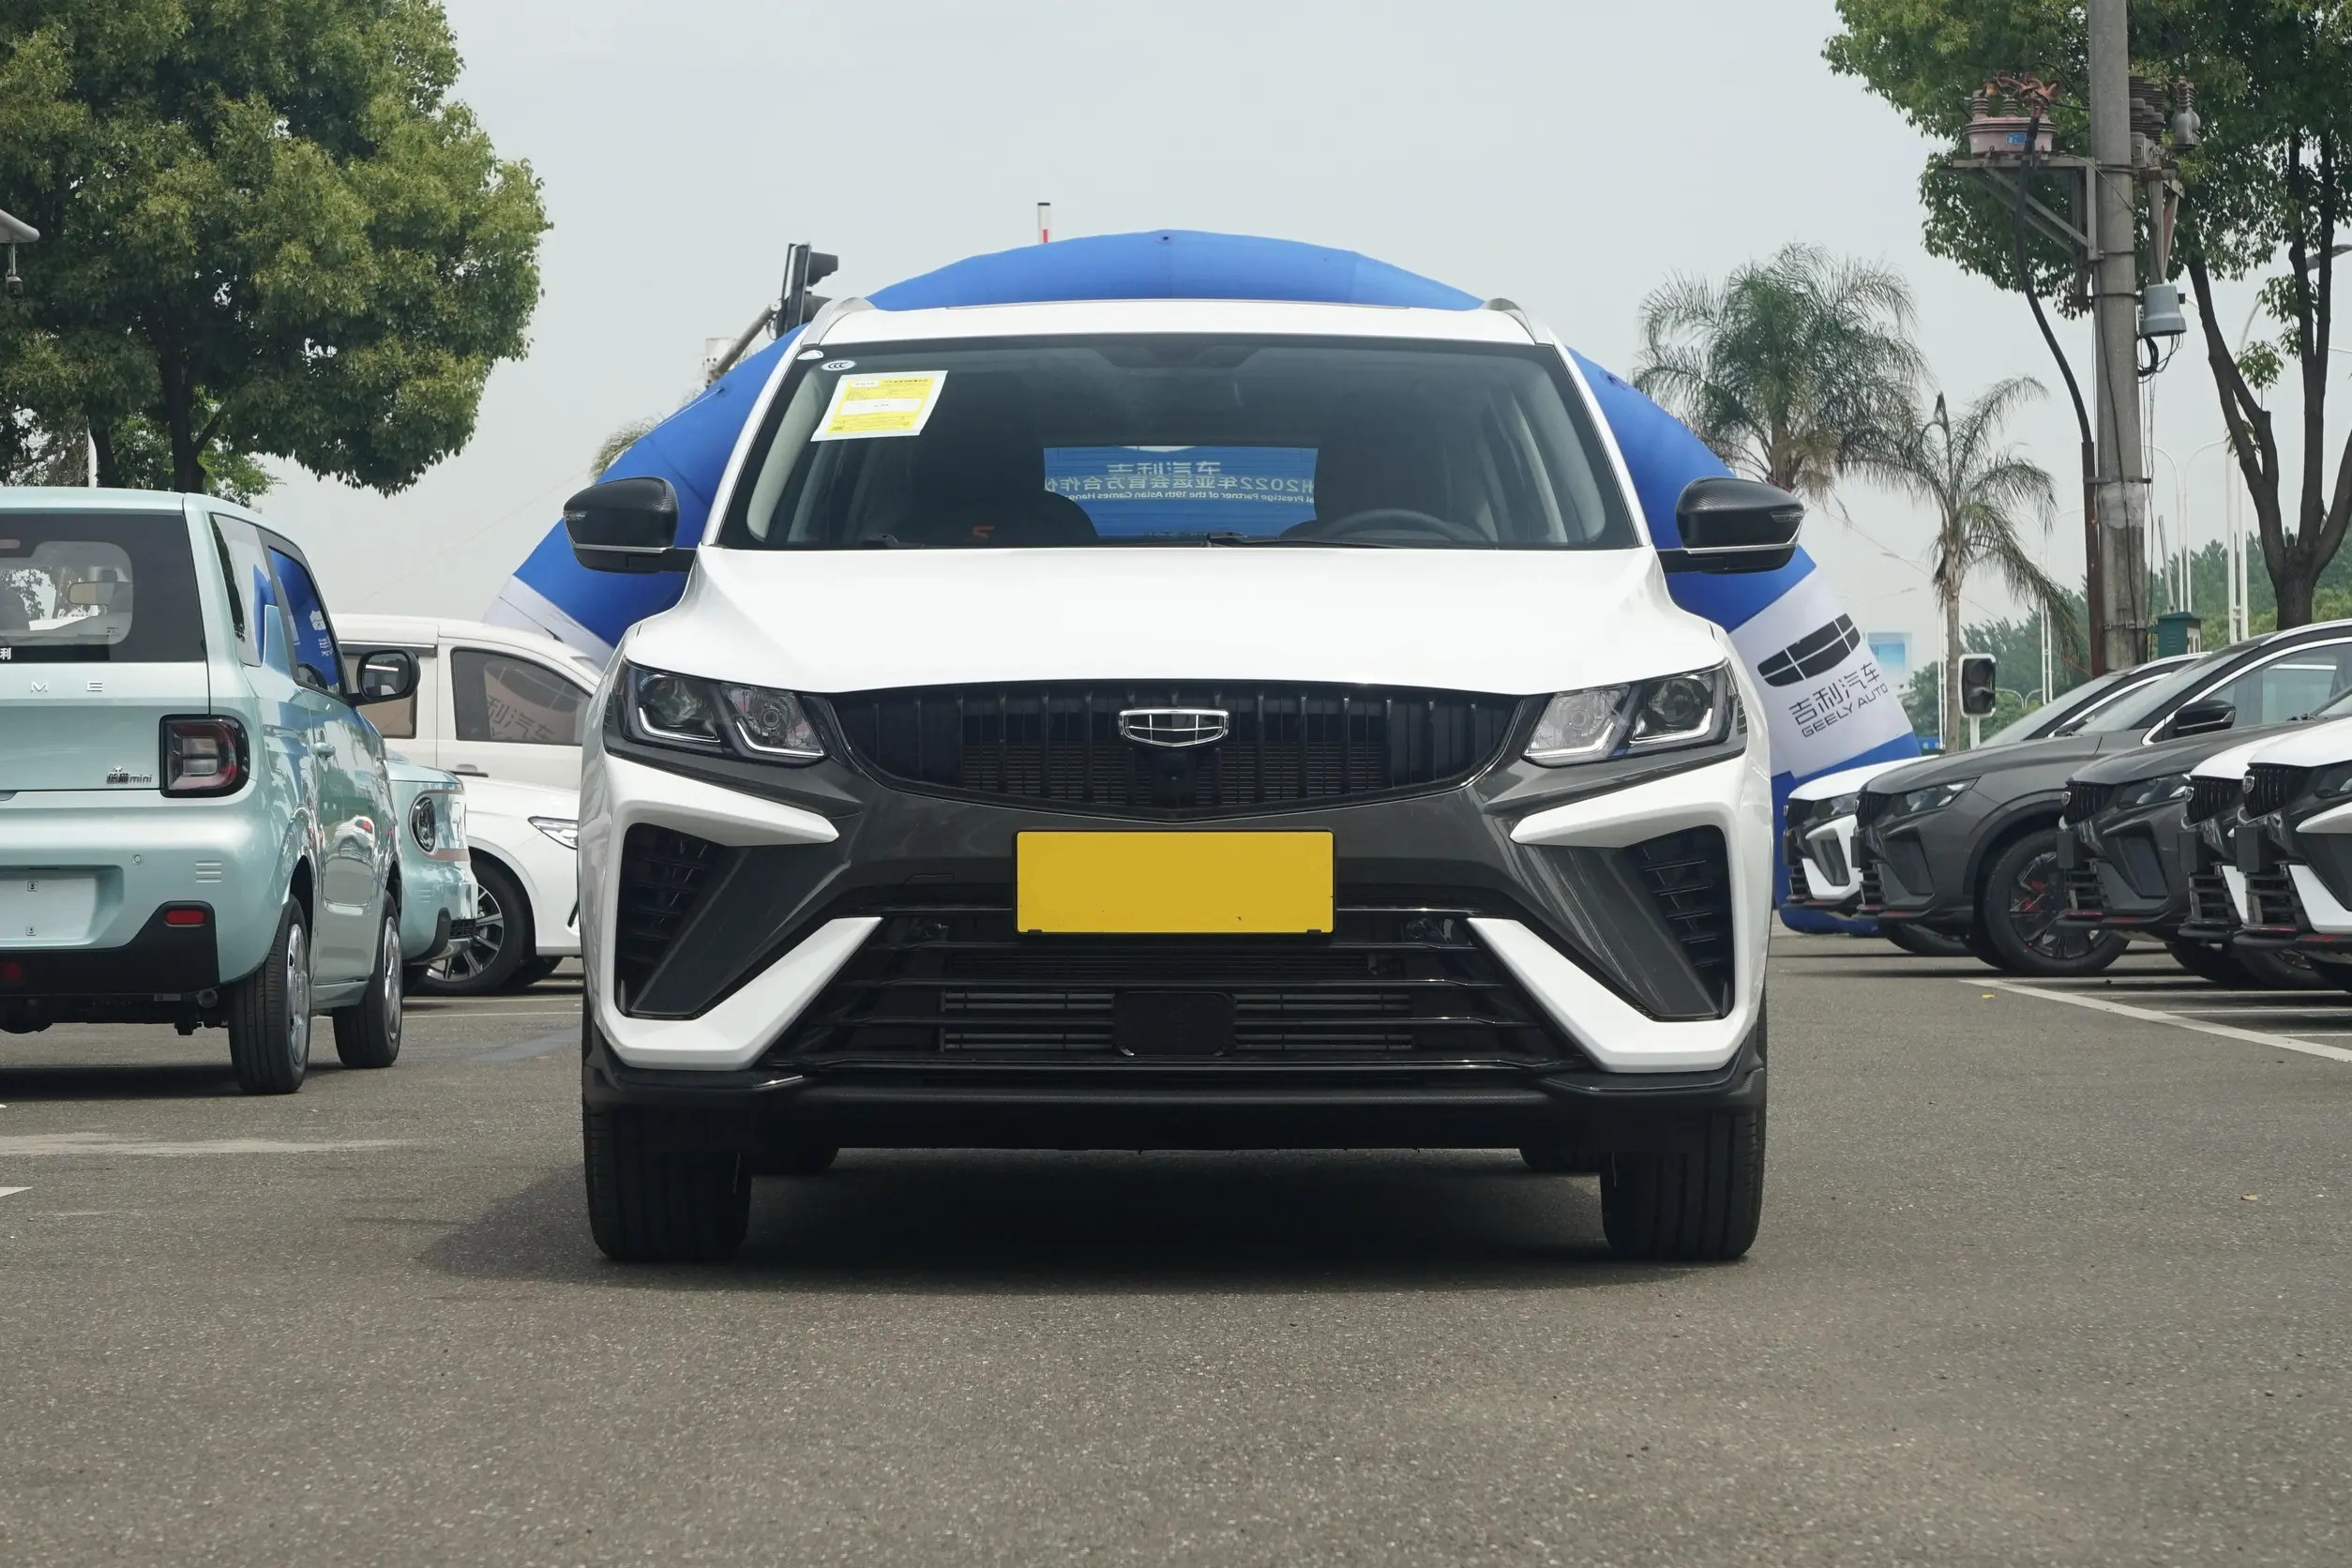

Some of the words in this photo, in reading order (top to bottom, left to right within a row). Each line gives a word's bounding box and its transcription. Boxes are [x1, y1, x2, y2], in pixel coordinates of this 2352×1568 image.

[1788, 662, 1880, 726] 吉利汽车
[1802, 704, 1853, 738] GEELY
[1858, 683, 1889, 710] AUTO
